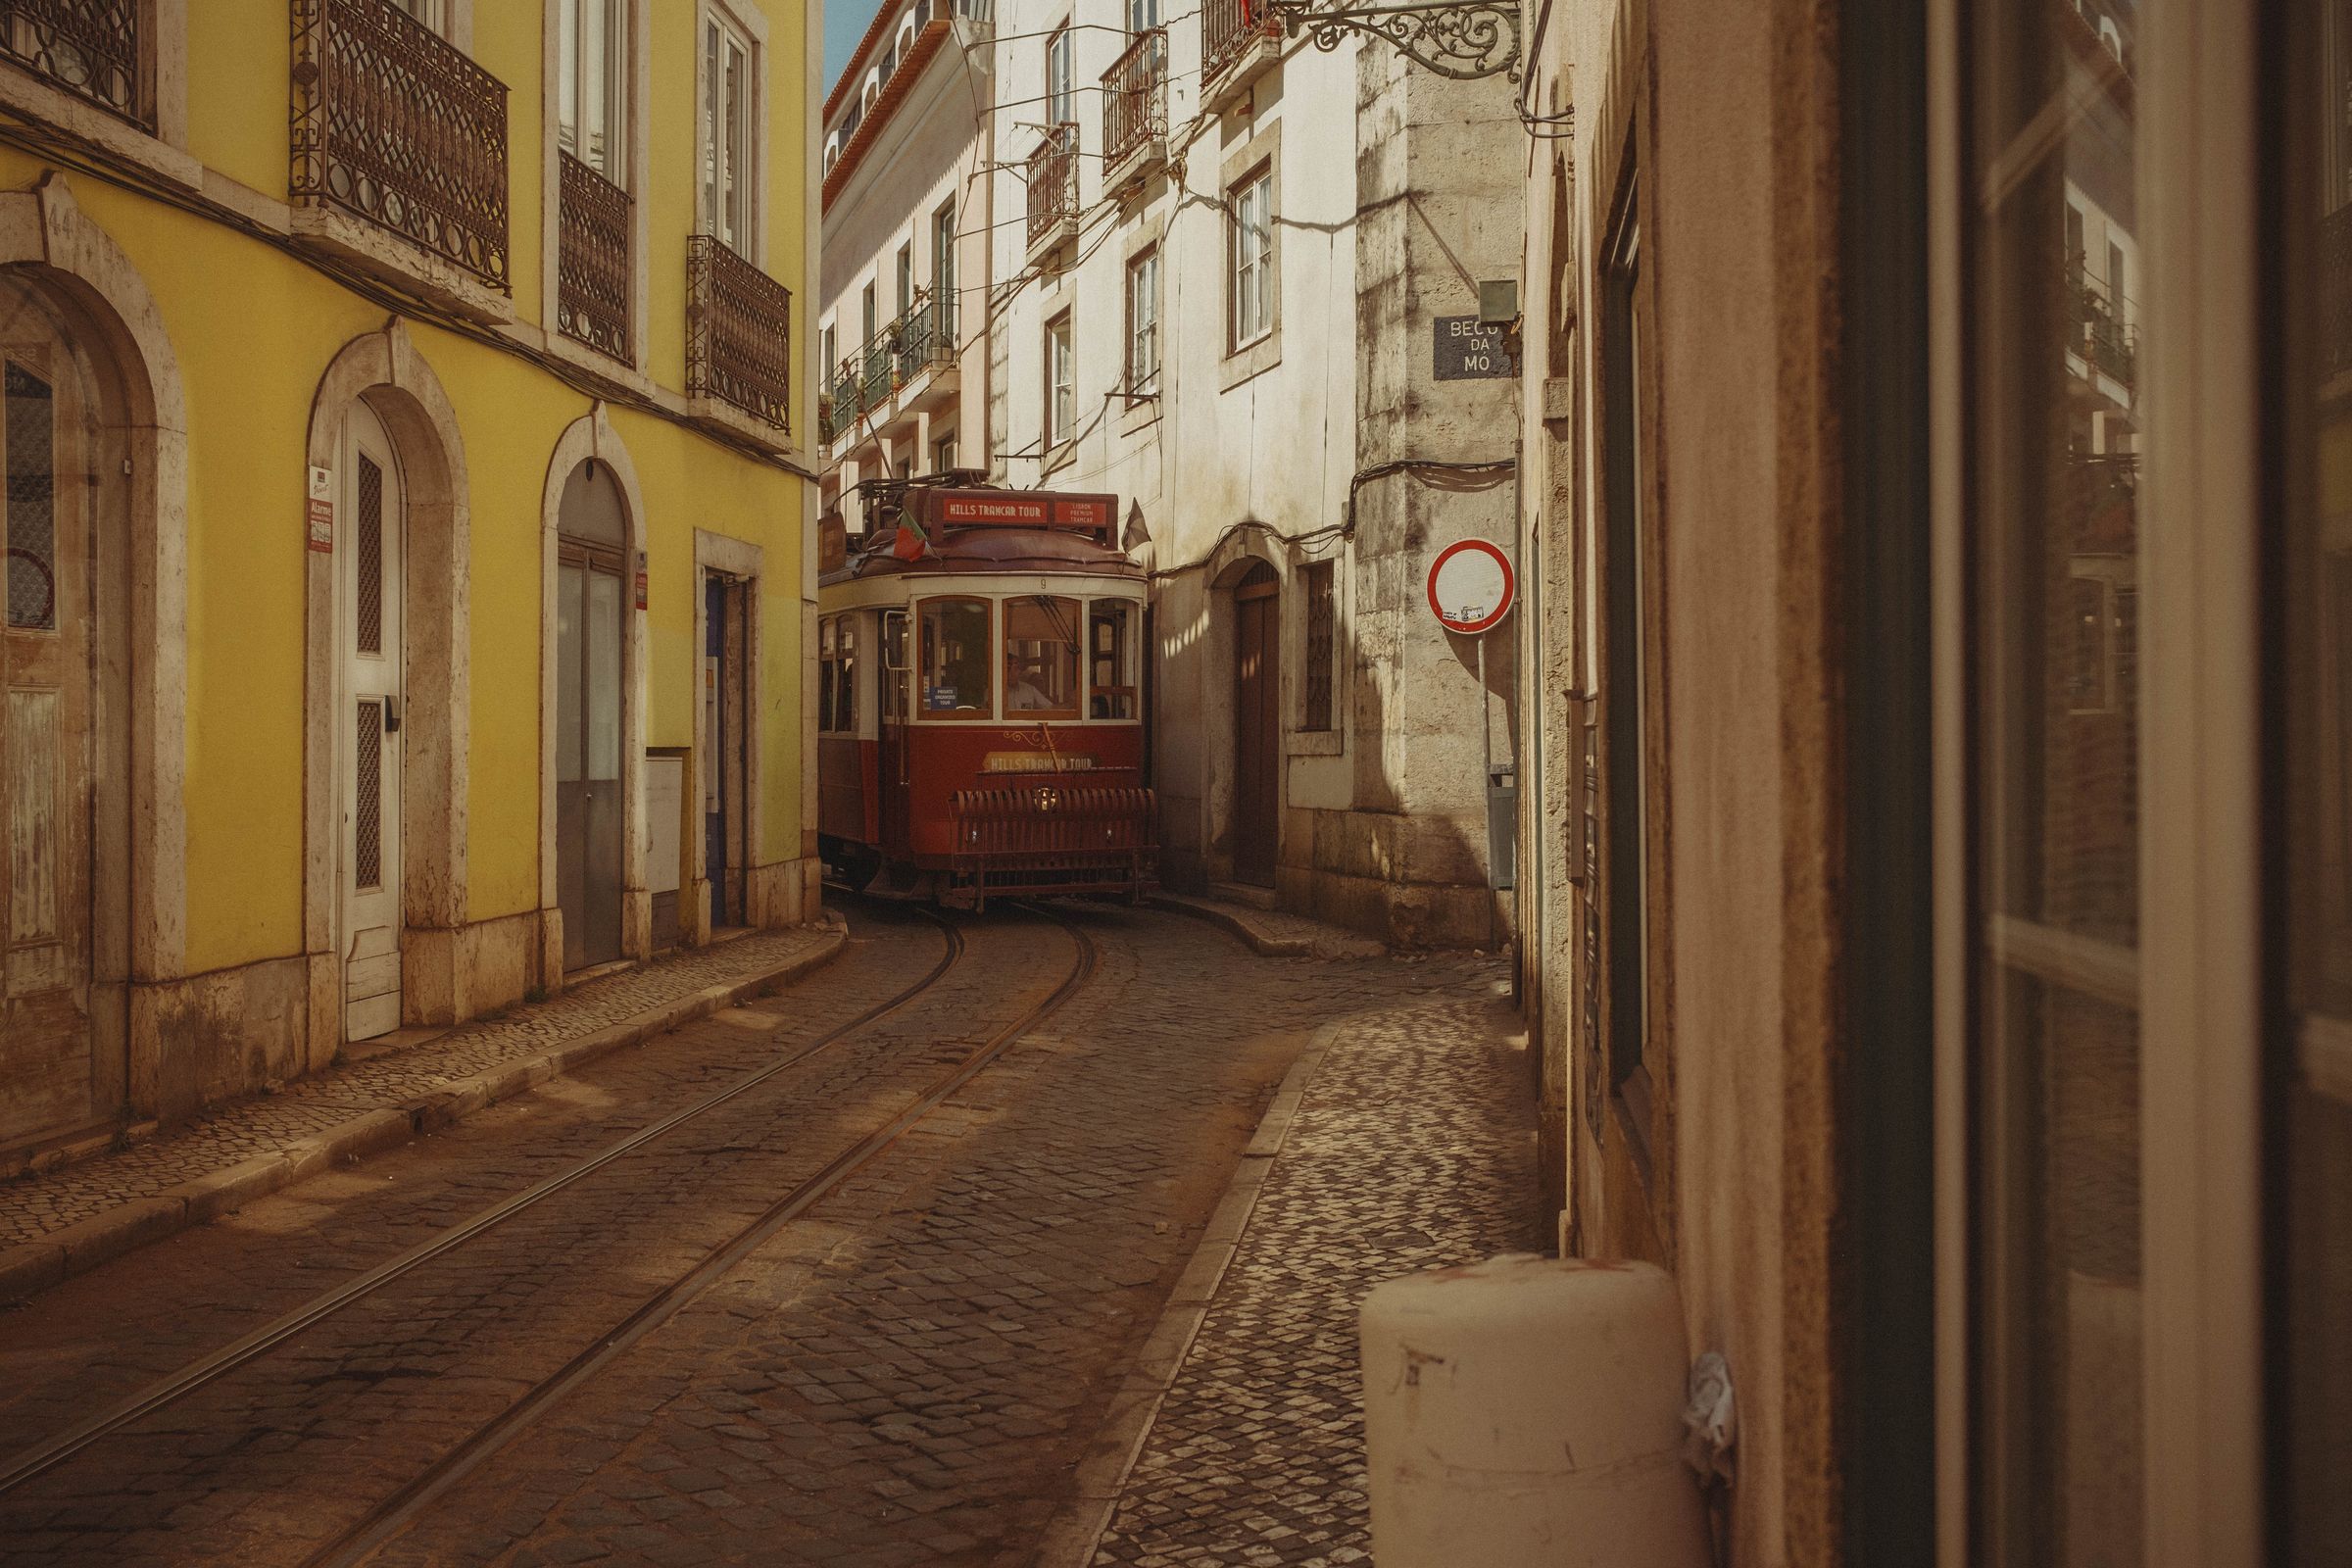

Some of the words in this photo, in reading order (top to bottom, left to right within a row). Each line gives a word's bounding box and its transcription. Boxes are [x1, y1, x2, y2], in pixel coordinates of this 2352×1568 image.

[1471, 338, 1490, 351] DA
[311, 501, 332, 516] Alarme
[950, 504, 976, 515] HILLS
[978, 505, 1016, 516] TRAMCAR
[1018, 506, 1041, 517] TOUR
[1041, 578, 1047, 590] 9
[991, 758, 1021, 769] HILLS
[1069, 758, 1093, 769] TOUR
